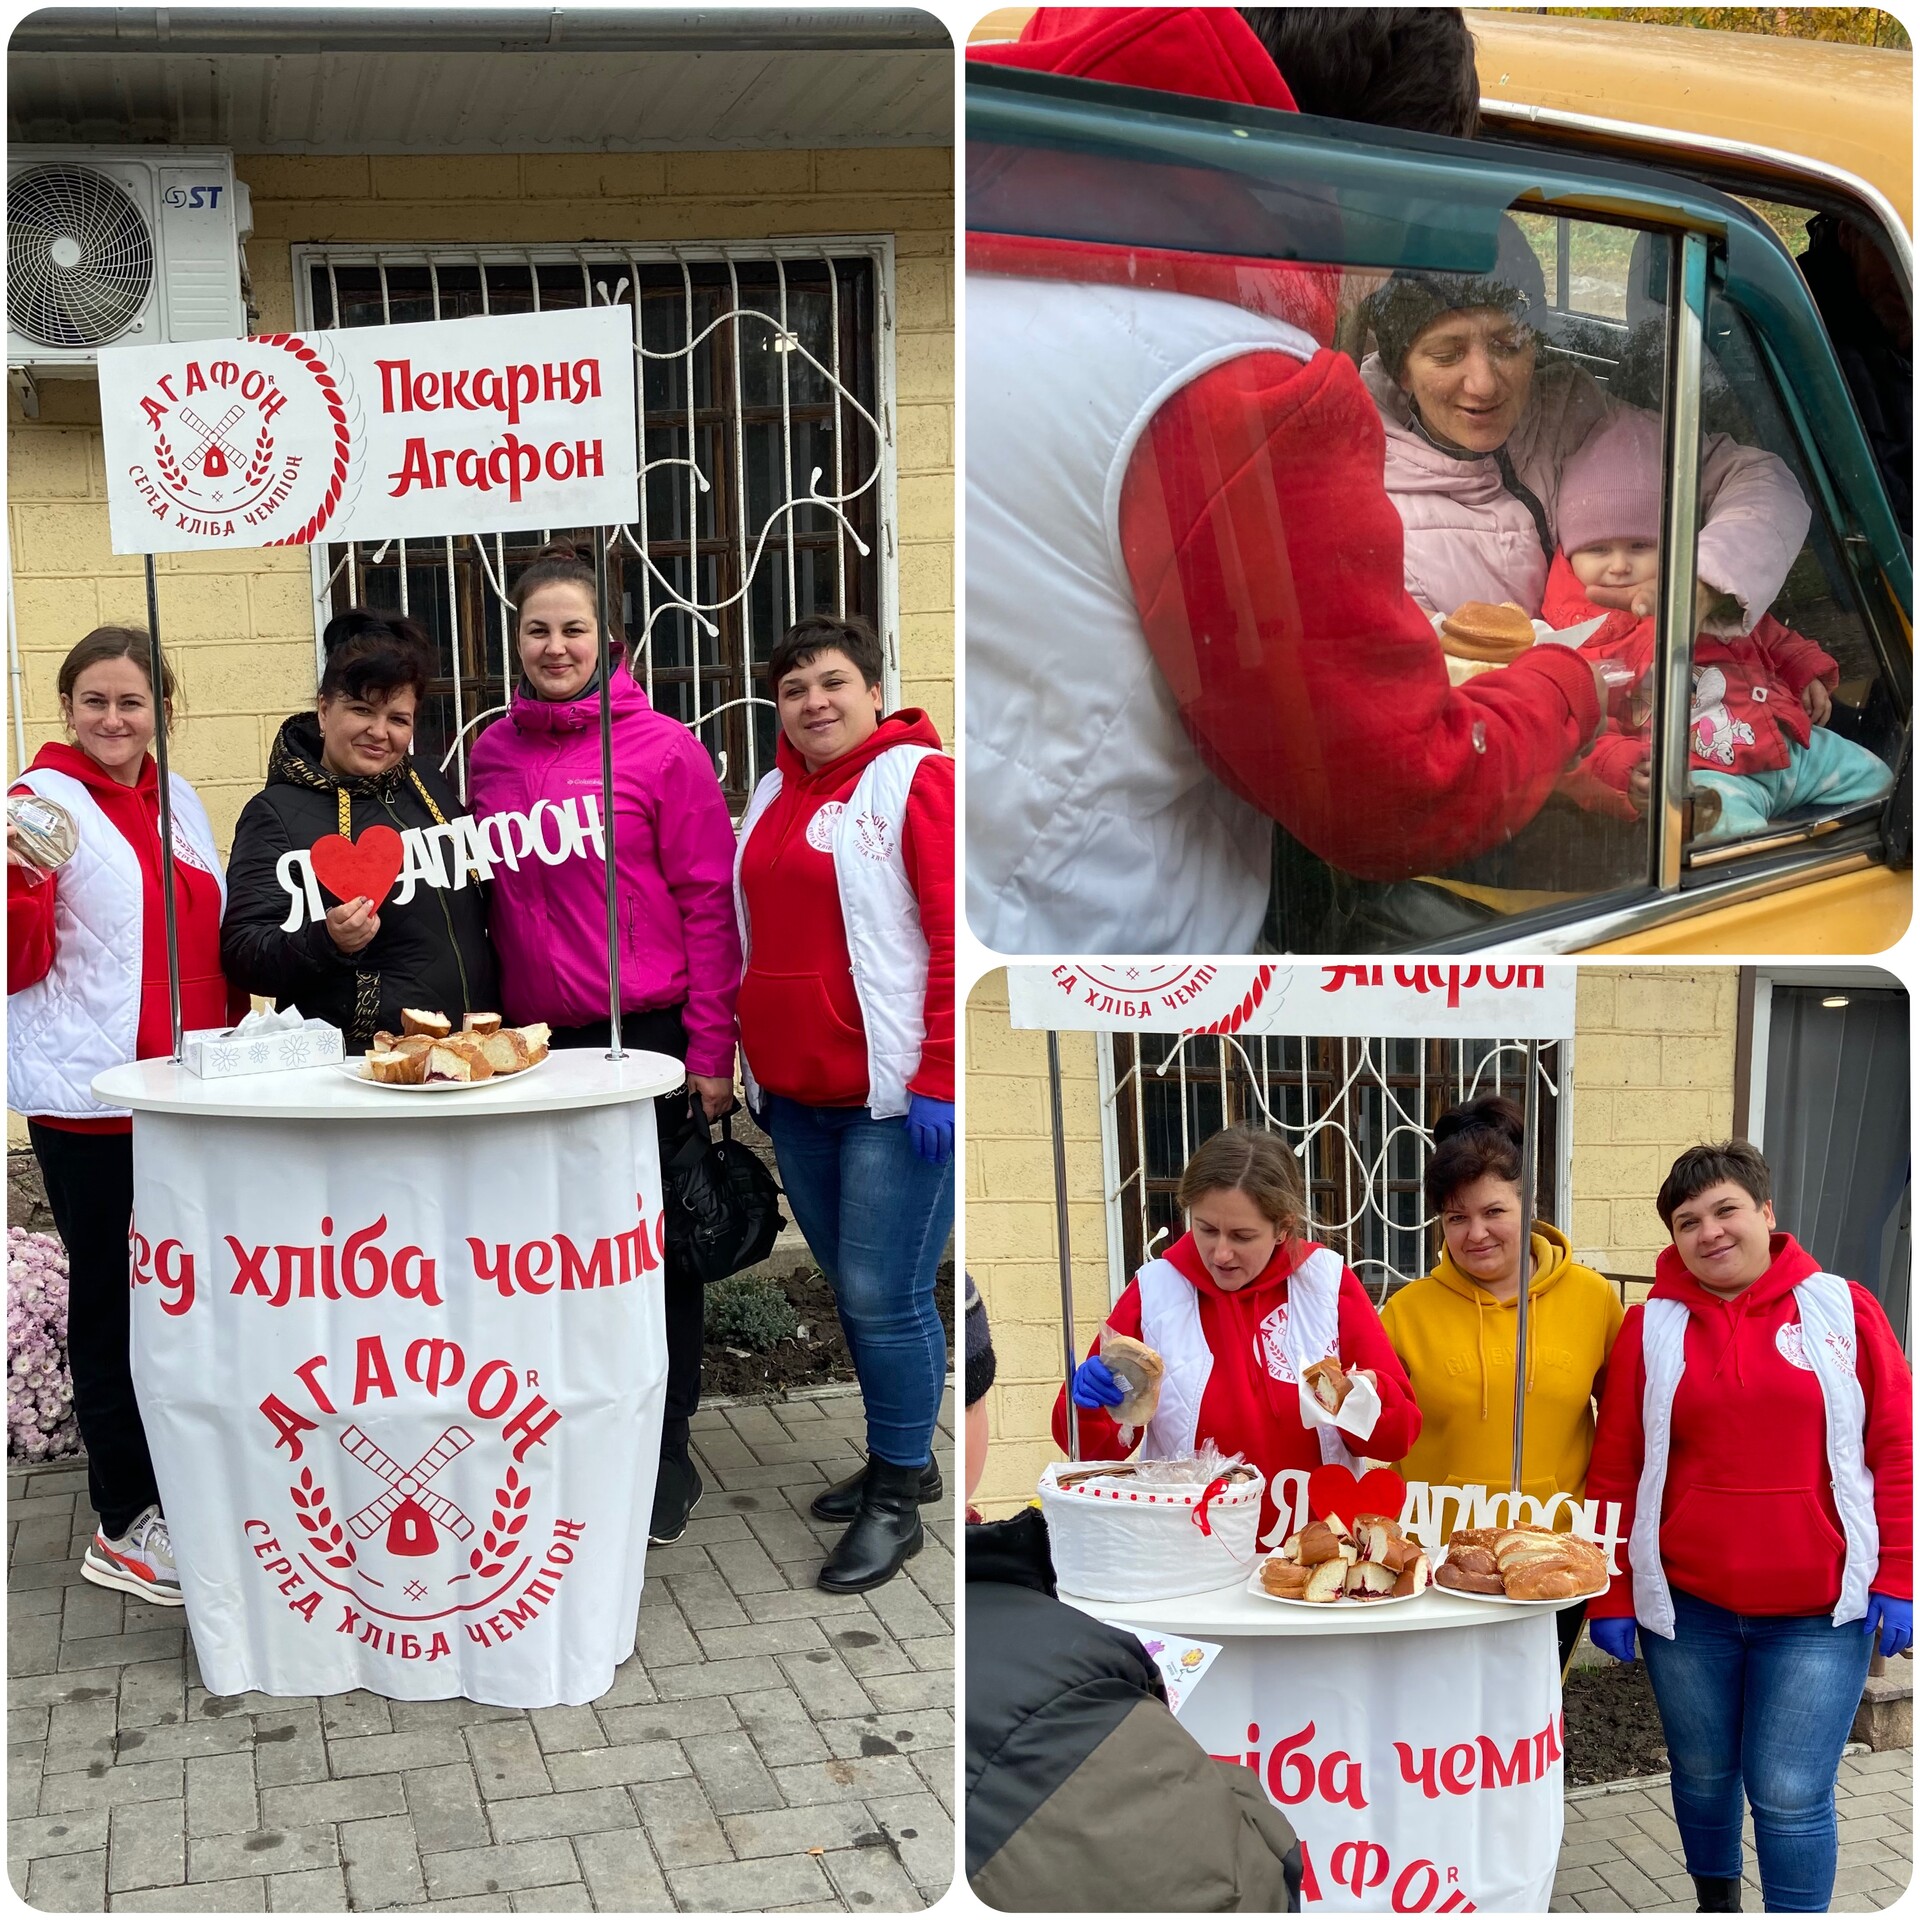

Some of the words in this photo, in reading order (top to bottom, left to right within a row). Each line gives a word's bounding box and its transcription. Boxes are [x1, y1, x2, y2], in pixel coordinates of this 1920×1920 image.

[189, 186, 223, 209] ST
[139, 361, 288, 431] АГАФОН
[374, 358, 602, 426] Пекарня
[128, 465, 168, 521] СЕРЕД
[174, 512, 236, 537] ХЛІБА
[243, 455, 303, 528] ЧЕМПІОН
[388, 432, 604, 503] Агафон
[275, 848, 327, 934] Я
[1084, 988, 1152, 1019] ХЛІБА
[224, 1216, 443, 1308] хліба
[258, 1335, 562, 1463] АГАФОН
[1260, 1469, 1310, 1548] Я
[244, 1518, 324, 1623] СЕРЕД
[336, 1605, 451, 1662] ХЛІБА
[467, 1517, 586, 1648] ЧЕМПІОН
